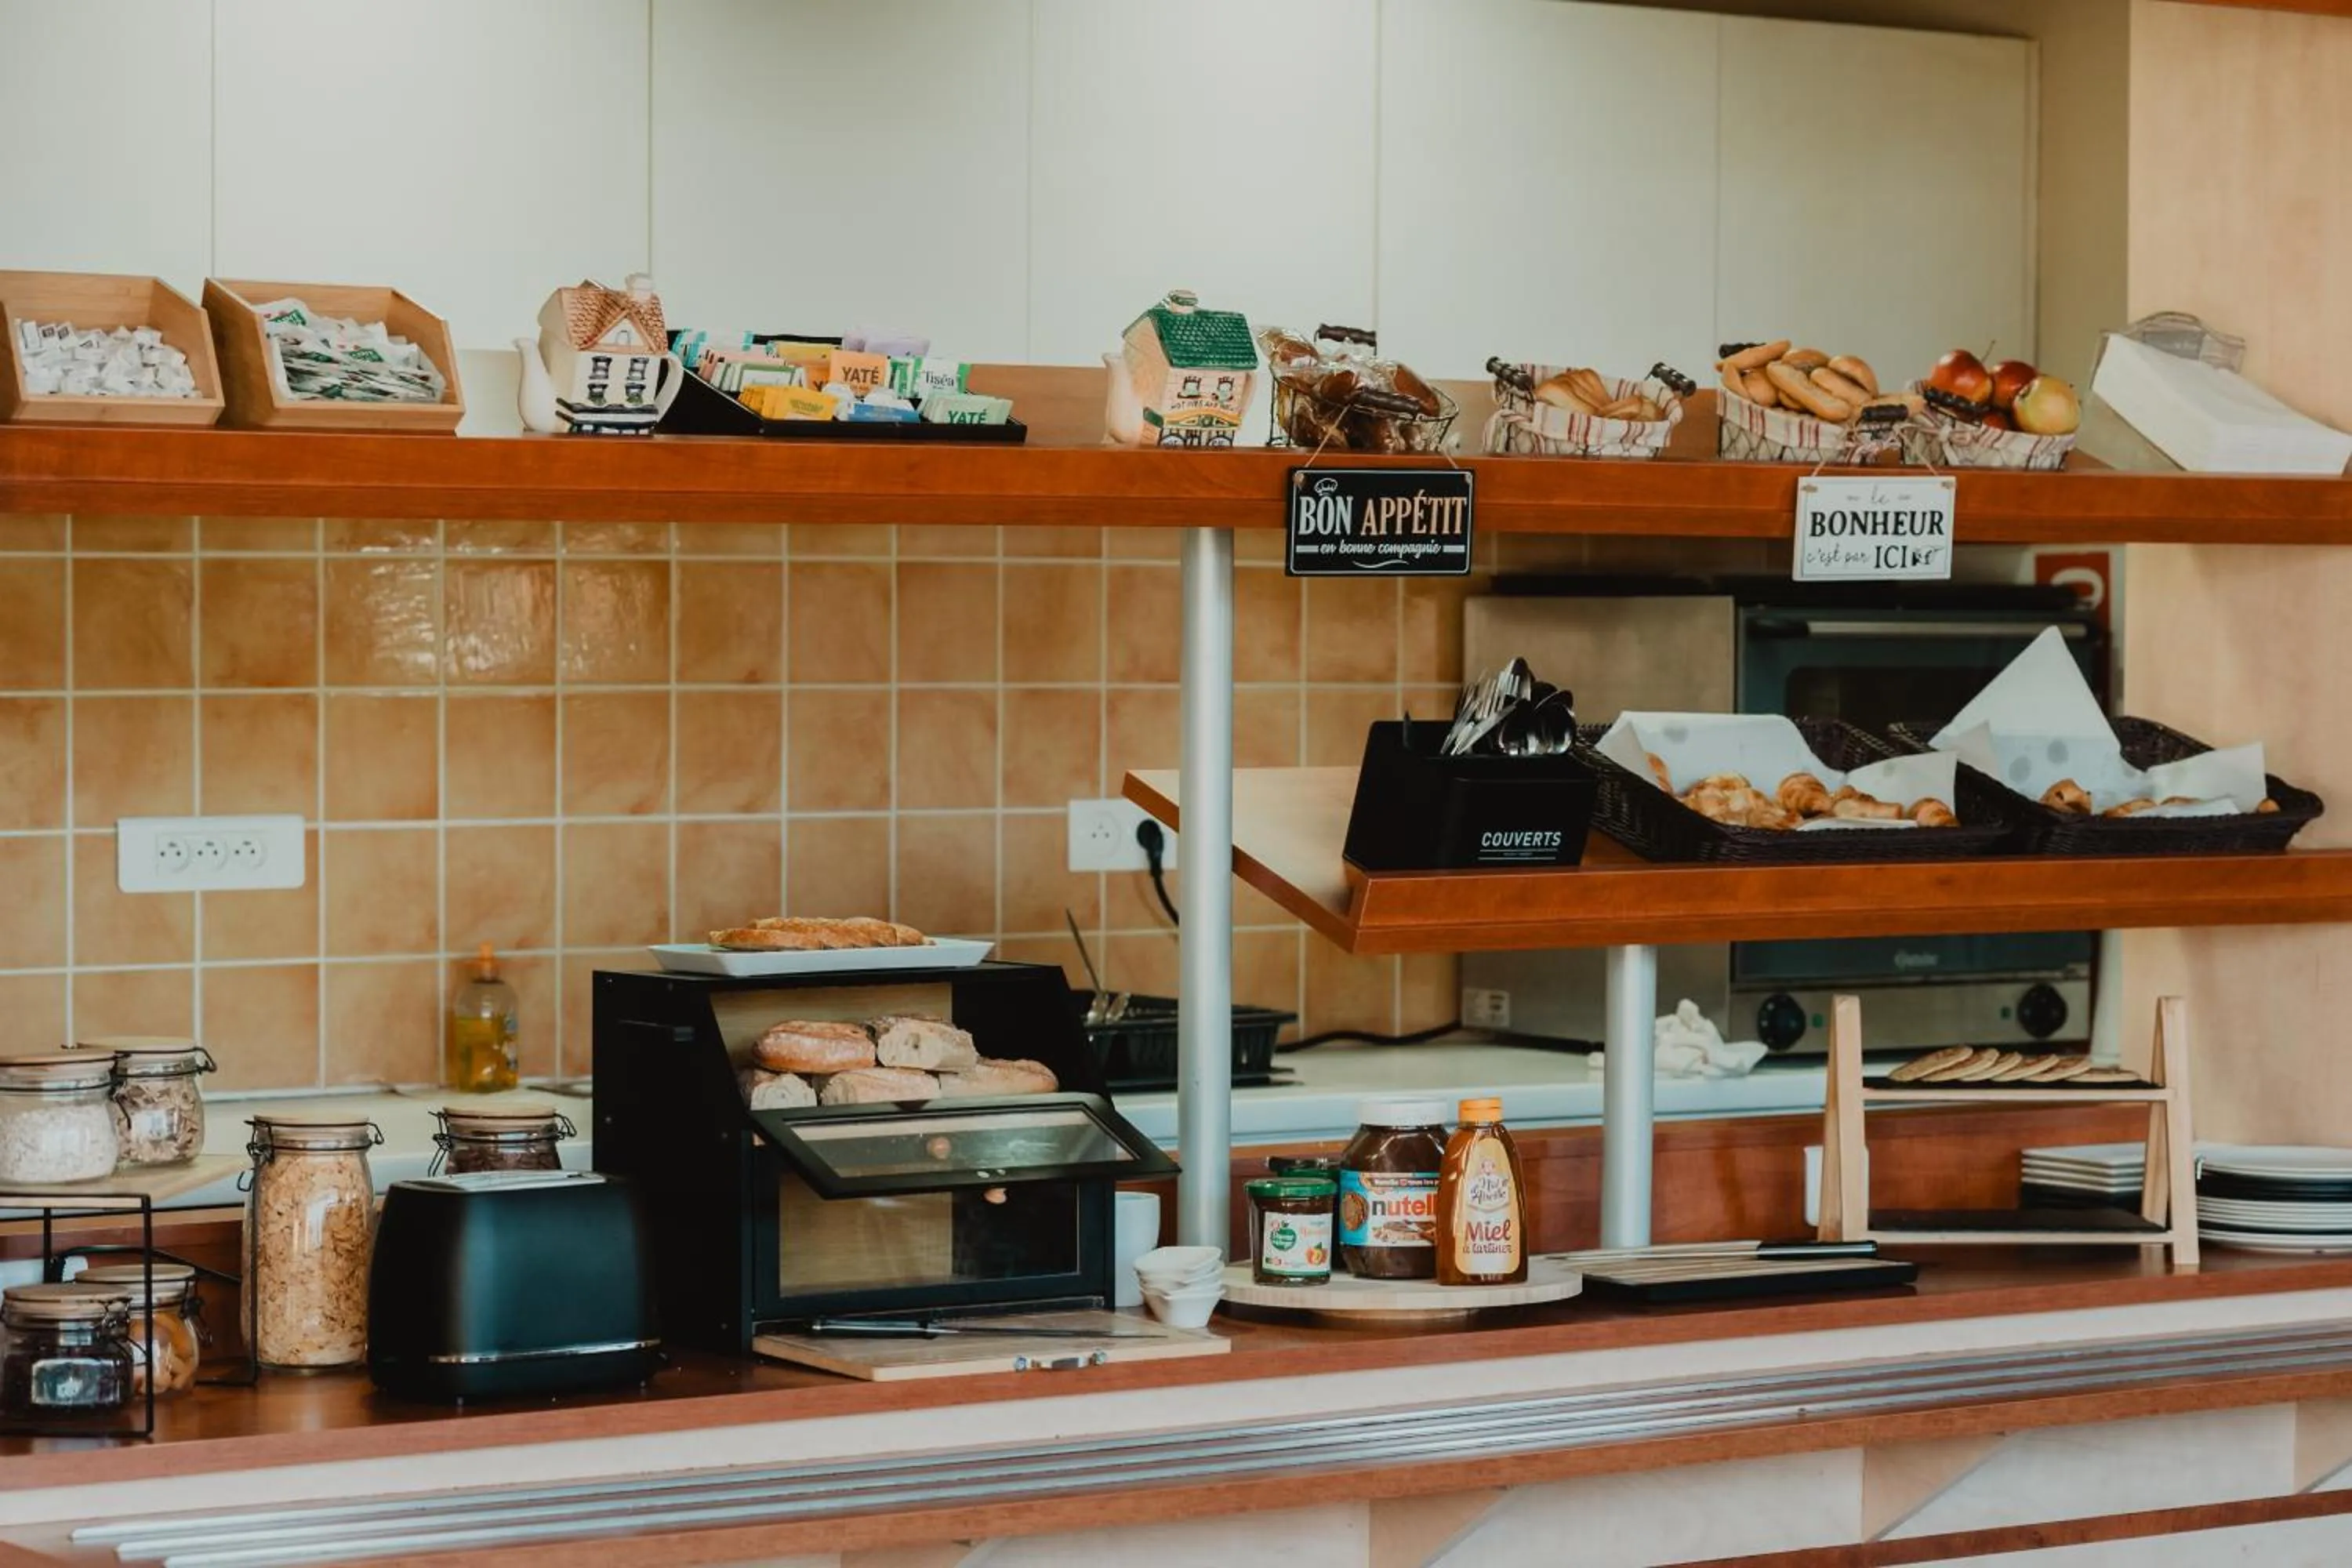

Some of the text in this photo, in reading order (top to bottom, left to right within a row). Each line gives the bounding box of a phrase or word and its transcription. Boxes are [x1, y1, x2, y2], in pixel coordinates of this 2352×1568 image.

[841, 366, 880, 385] YATÉ
[948, 408, 988, 424] YATÉ
[1871, 484, 1890, 504] le
[1298, 489, 1468, 535] BON APPÉTIT
[1809, 510, 1944, 537] BONHEUR
[1319, 539, 1442, 558] en bonne compagnie
[1806, 543, 1908, 568] c'est par ICI
[1481, 831, 1562, 847] COUVERTS
[1372, 1194, 1438, 1216] nutell
[1465, 1219, 1512, 1242] Miel
